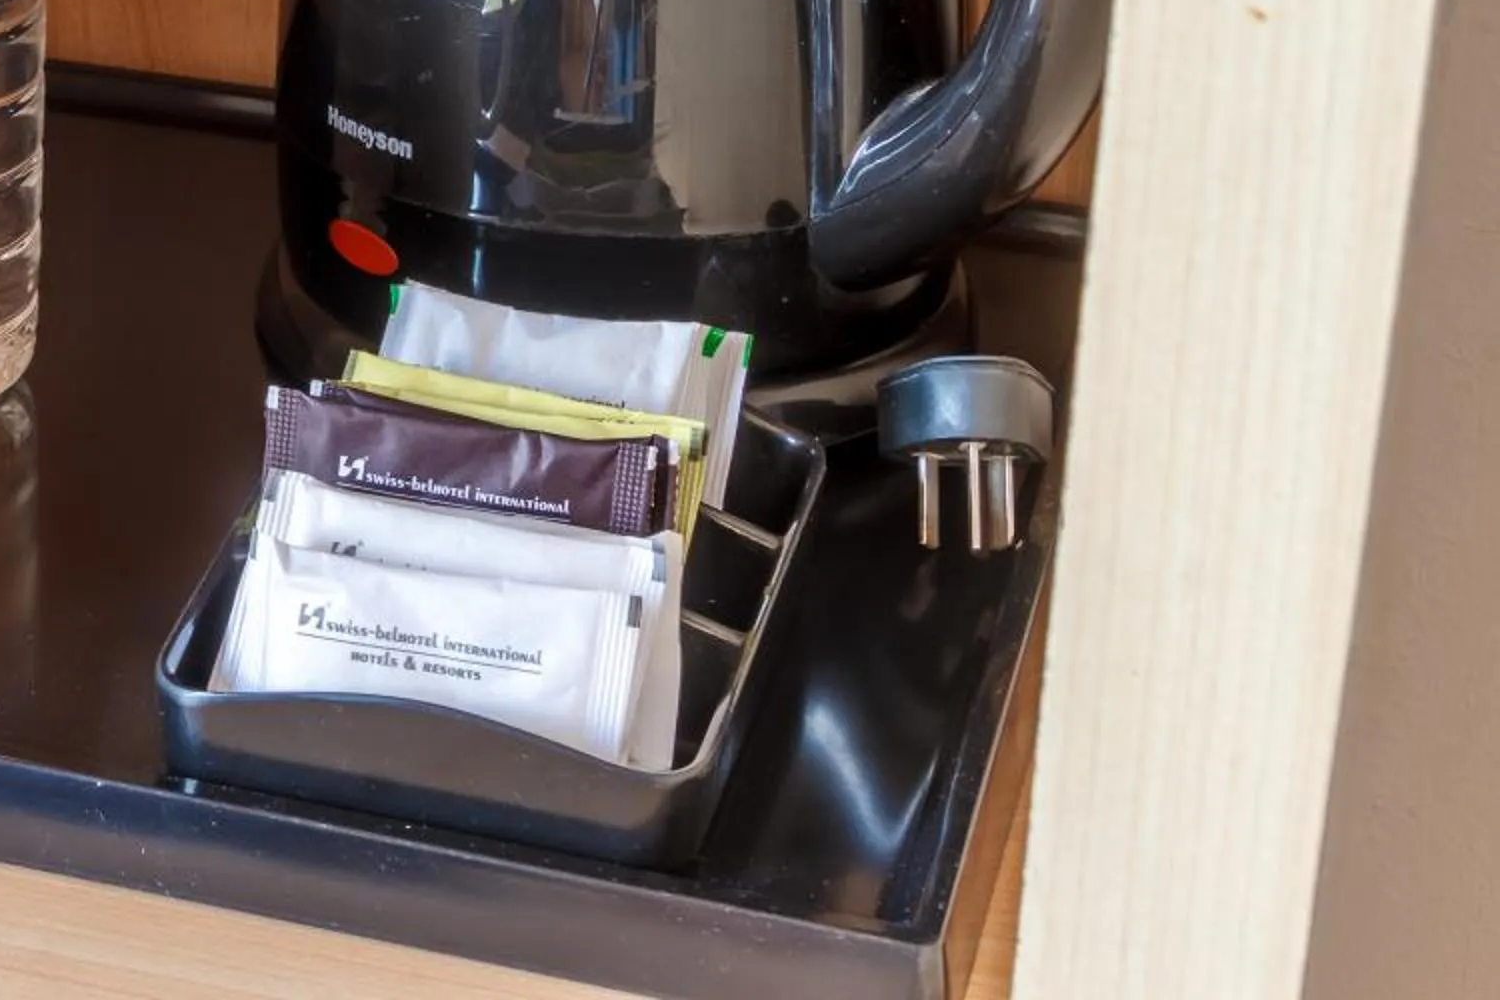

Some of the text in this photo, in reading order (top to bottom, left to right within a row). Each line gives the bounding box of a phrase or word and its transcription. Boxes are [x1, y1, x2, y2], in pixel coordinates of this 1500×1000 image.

[327, 104, 413, 160] Honeyson
[403, 655, 417, 671] &
[422, 662, 482, 681] RESORTS
